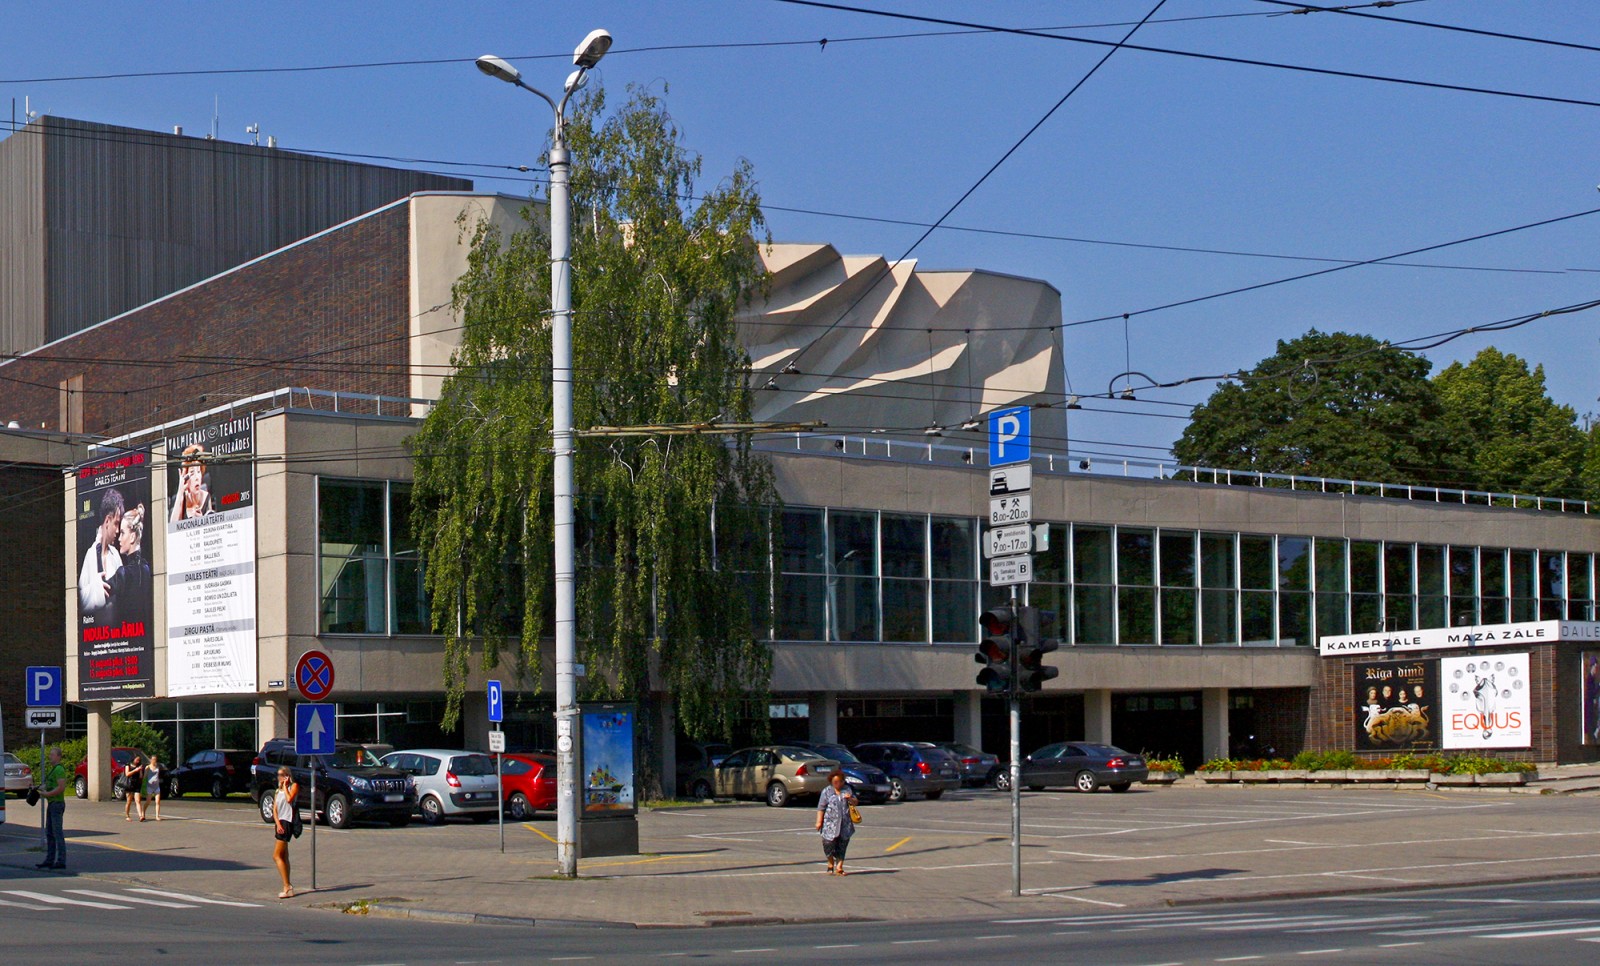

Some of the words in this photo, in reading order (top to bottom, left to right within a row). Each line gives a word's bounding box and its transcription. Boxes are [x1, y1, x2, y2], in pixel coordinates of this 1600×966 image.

[168, 429, 206, 451] VALMIERAS
[998, 415, 1020, 458] P
[993, 509, 1028, 522] 8.00-20.00
[993, 539, 1028, 552] 9.00-17.00
[1020, 564, 1027, 573] B
[185, 572, 203, 582] DAILES
[83, 625, 110, 642] INDULIS
[111, 628, 121, 639] un
[1502, 628, 1545, 639] ZĀLE
[1327, 635, 1421, 650] KAMERZĀLE
[35, 671, 54, 701] P
[490, 686, 499, 716] P
[1452, 711, 1522, 731] EQUUS
